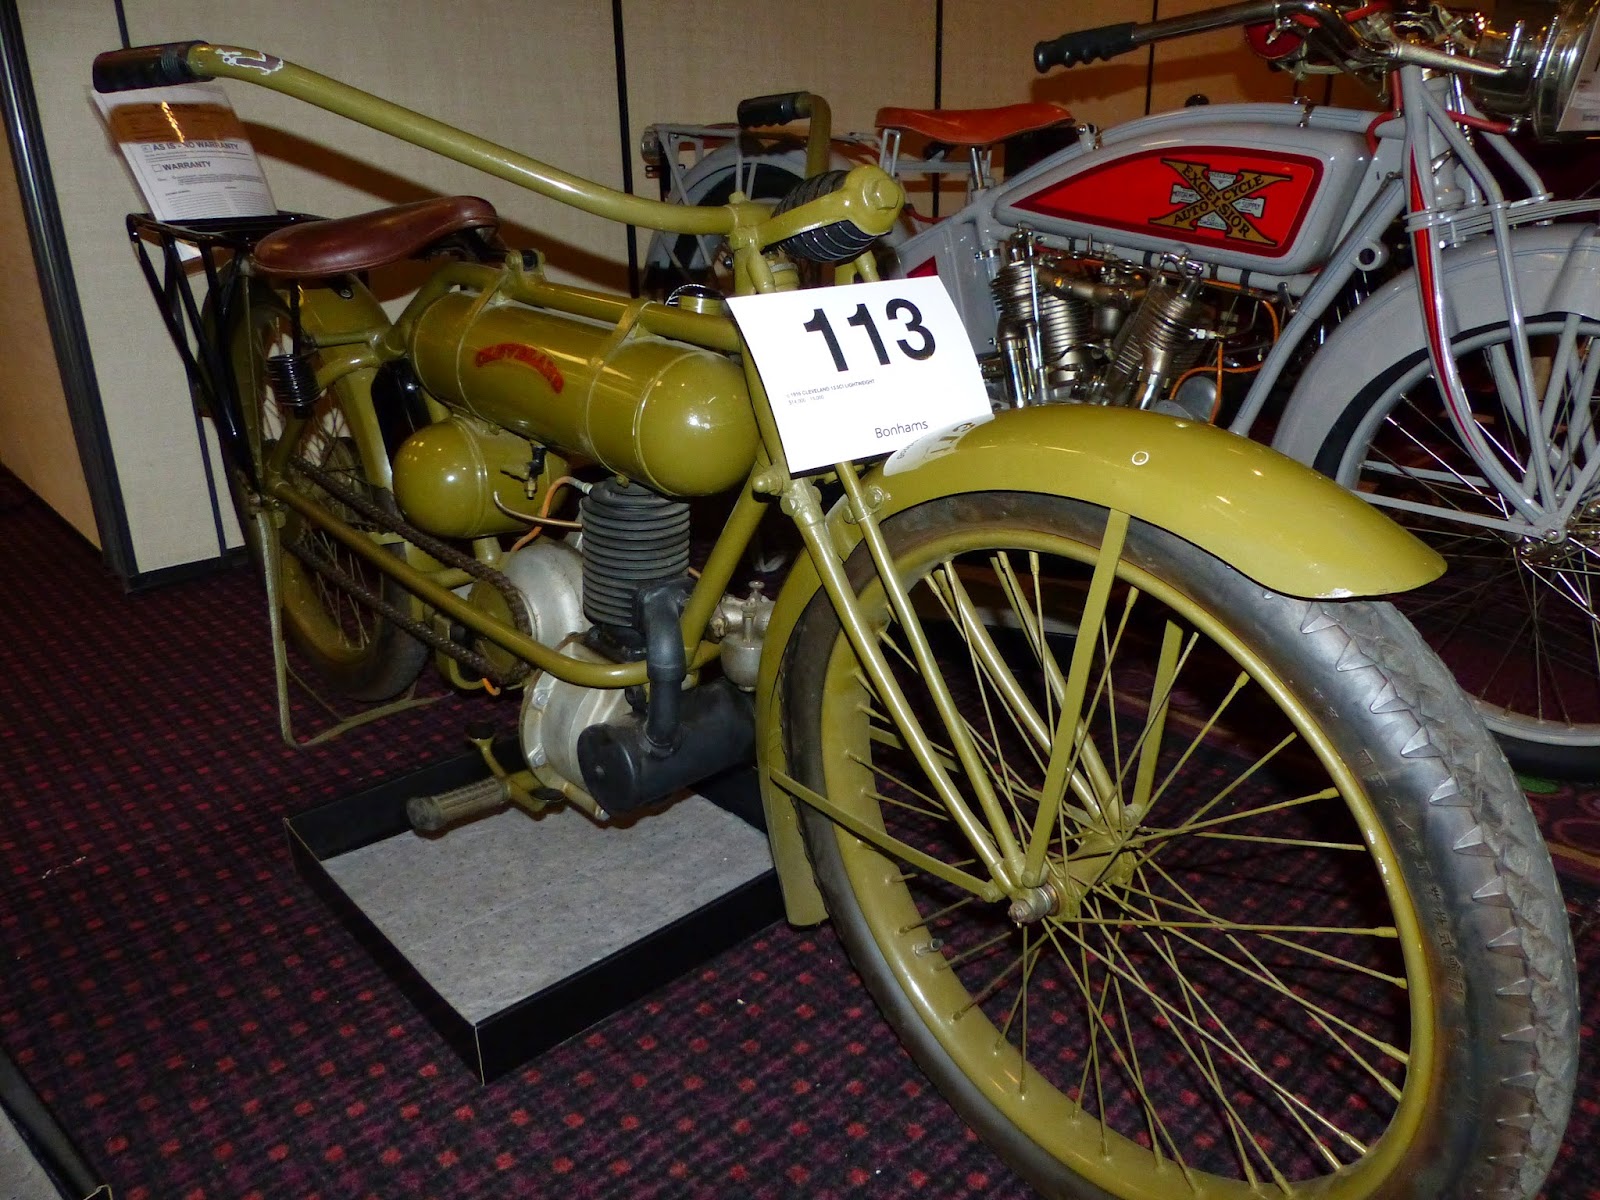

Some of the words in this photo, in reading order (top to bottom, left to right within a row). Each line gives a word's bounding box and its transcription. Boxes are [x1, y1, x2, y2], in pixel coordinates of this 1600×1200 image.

[153, 143, 166, 151] AS
[196, 141, 239, 151] WARRANTY
[162, 161, 212, 171] WARRANTY
[1174, 201, 1209, 225] AUTO
[1221, 174, 1264, 201] CYCLE
[1182, 164, 1251, 239] EXCELSIOR
[802, 297, 937, 373] 113
[801, 386, 830, 396] CLEVELAND
[844, 379, 875, 389] LIGHTWEIGHT
[874, 419, 929, 439] Bonhams
